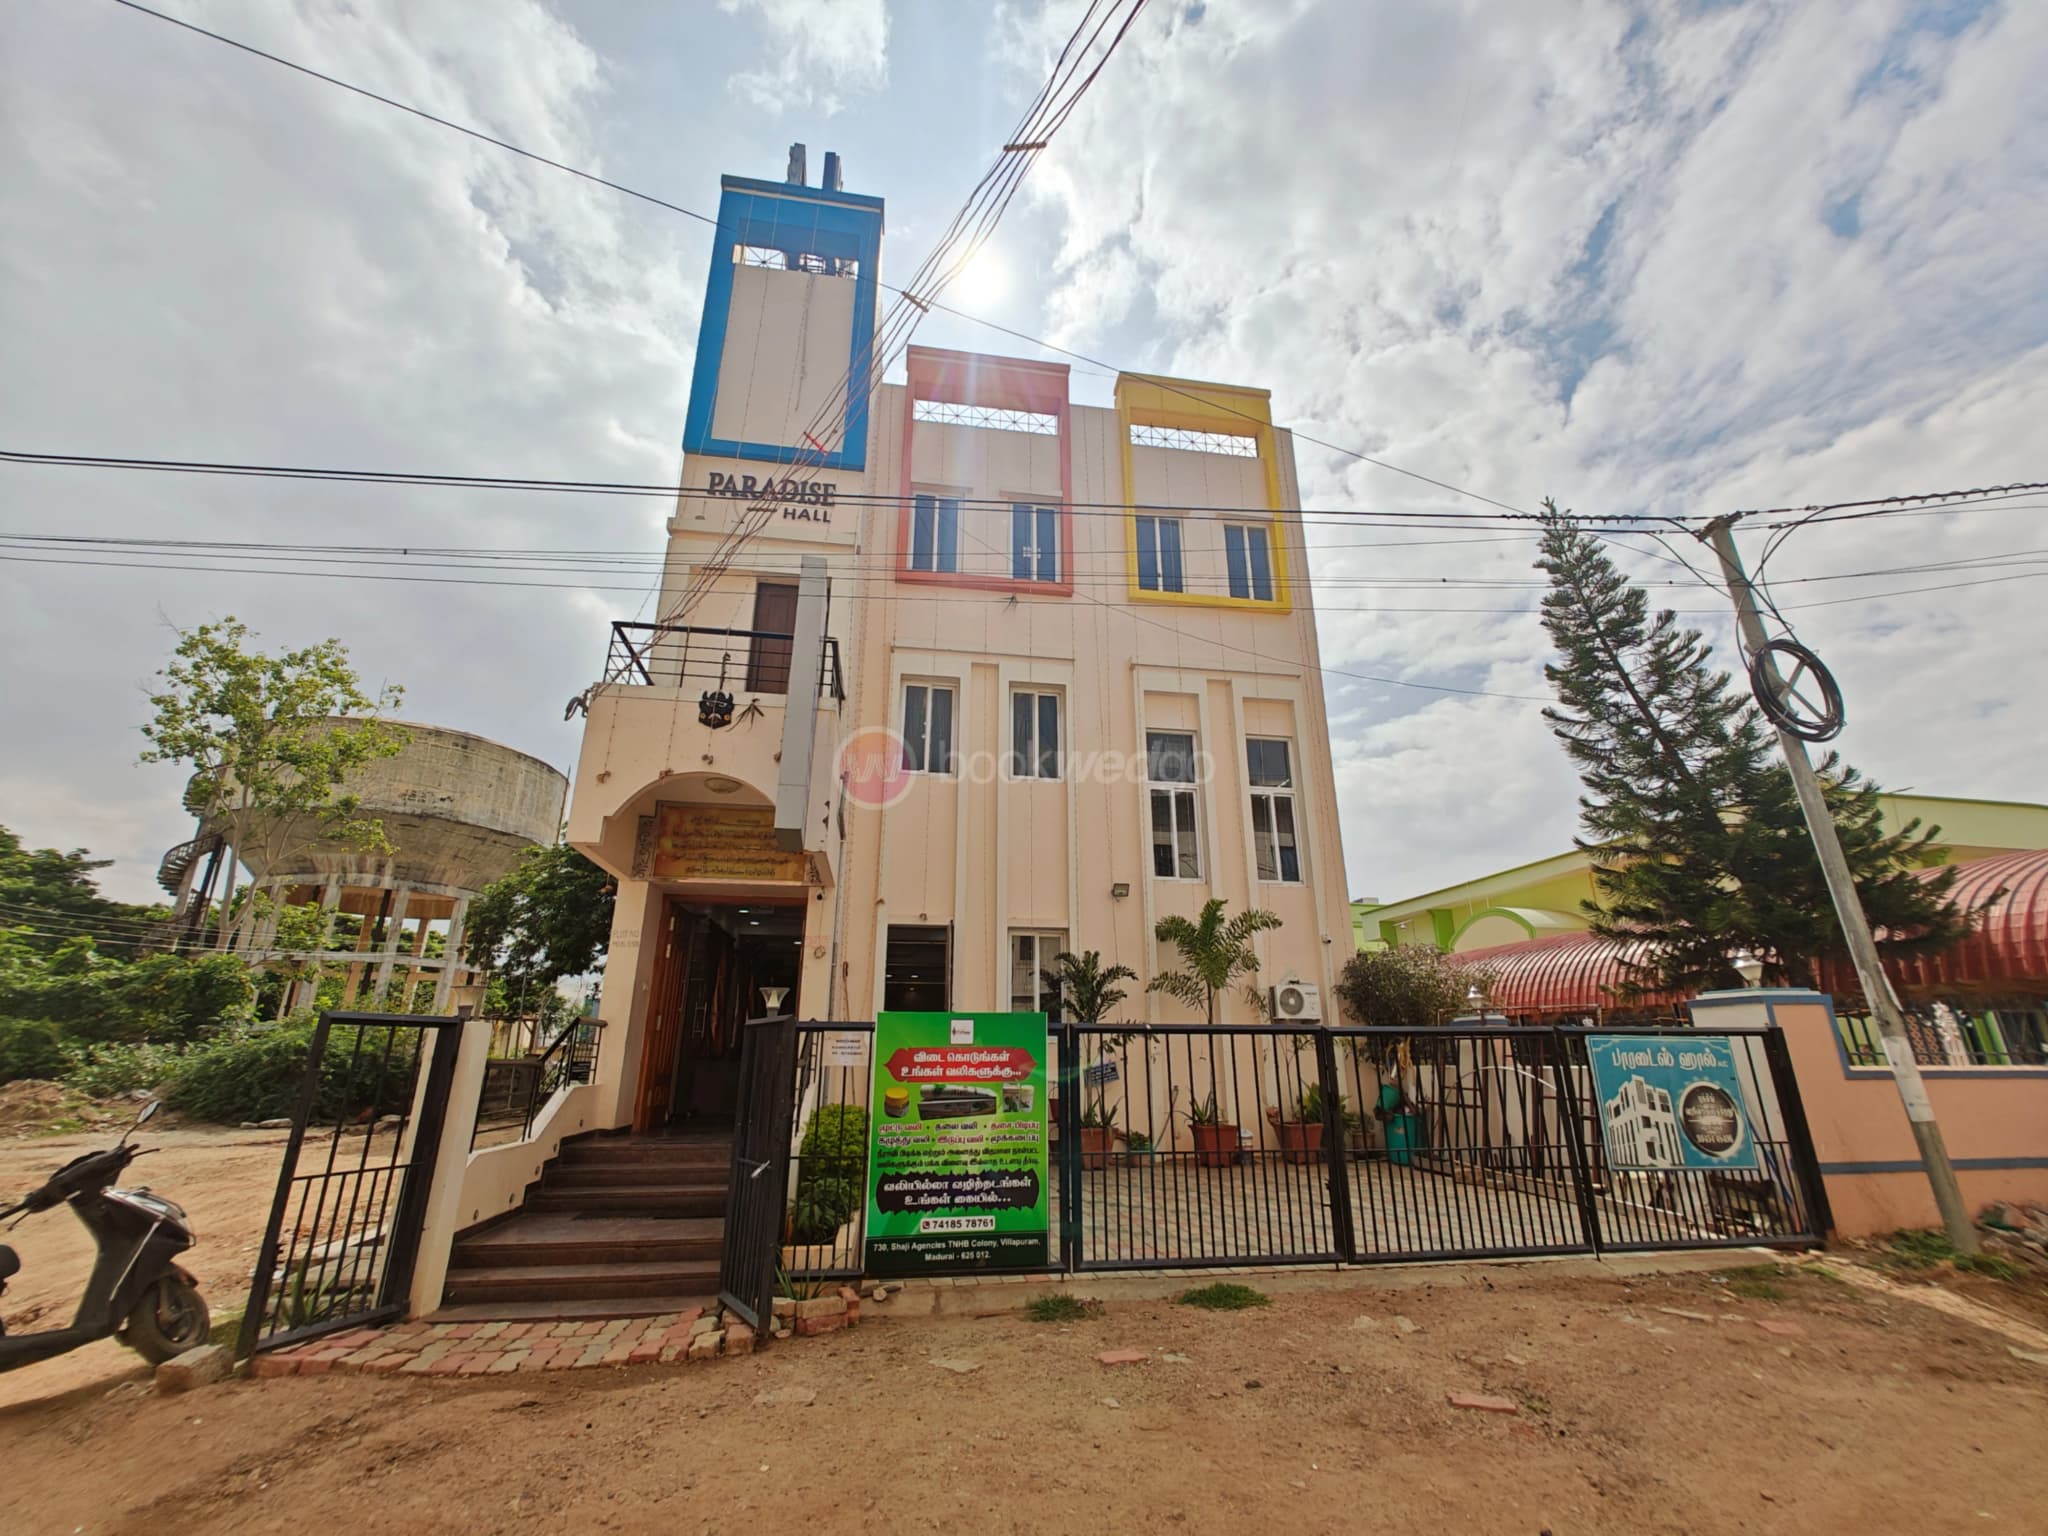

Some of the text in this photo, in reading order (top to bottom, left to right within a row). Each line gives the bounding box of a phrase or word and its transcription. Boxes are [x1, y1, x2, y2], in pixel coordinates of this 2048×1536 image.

[707, 472, 836, 507] PARADISE
[783, 507, 831, 523] HALL
[1612, 1046, 1717, 1071] பாரடைஸ் ஹால்
[933, 1218, 994, 1229] 74185 78761
[911, 1241, 946, 1251] Agencies
[948, 1240, 969, 1248] TNHB
[924, 1253, 955, 1261] Madurai
